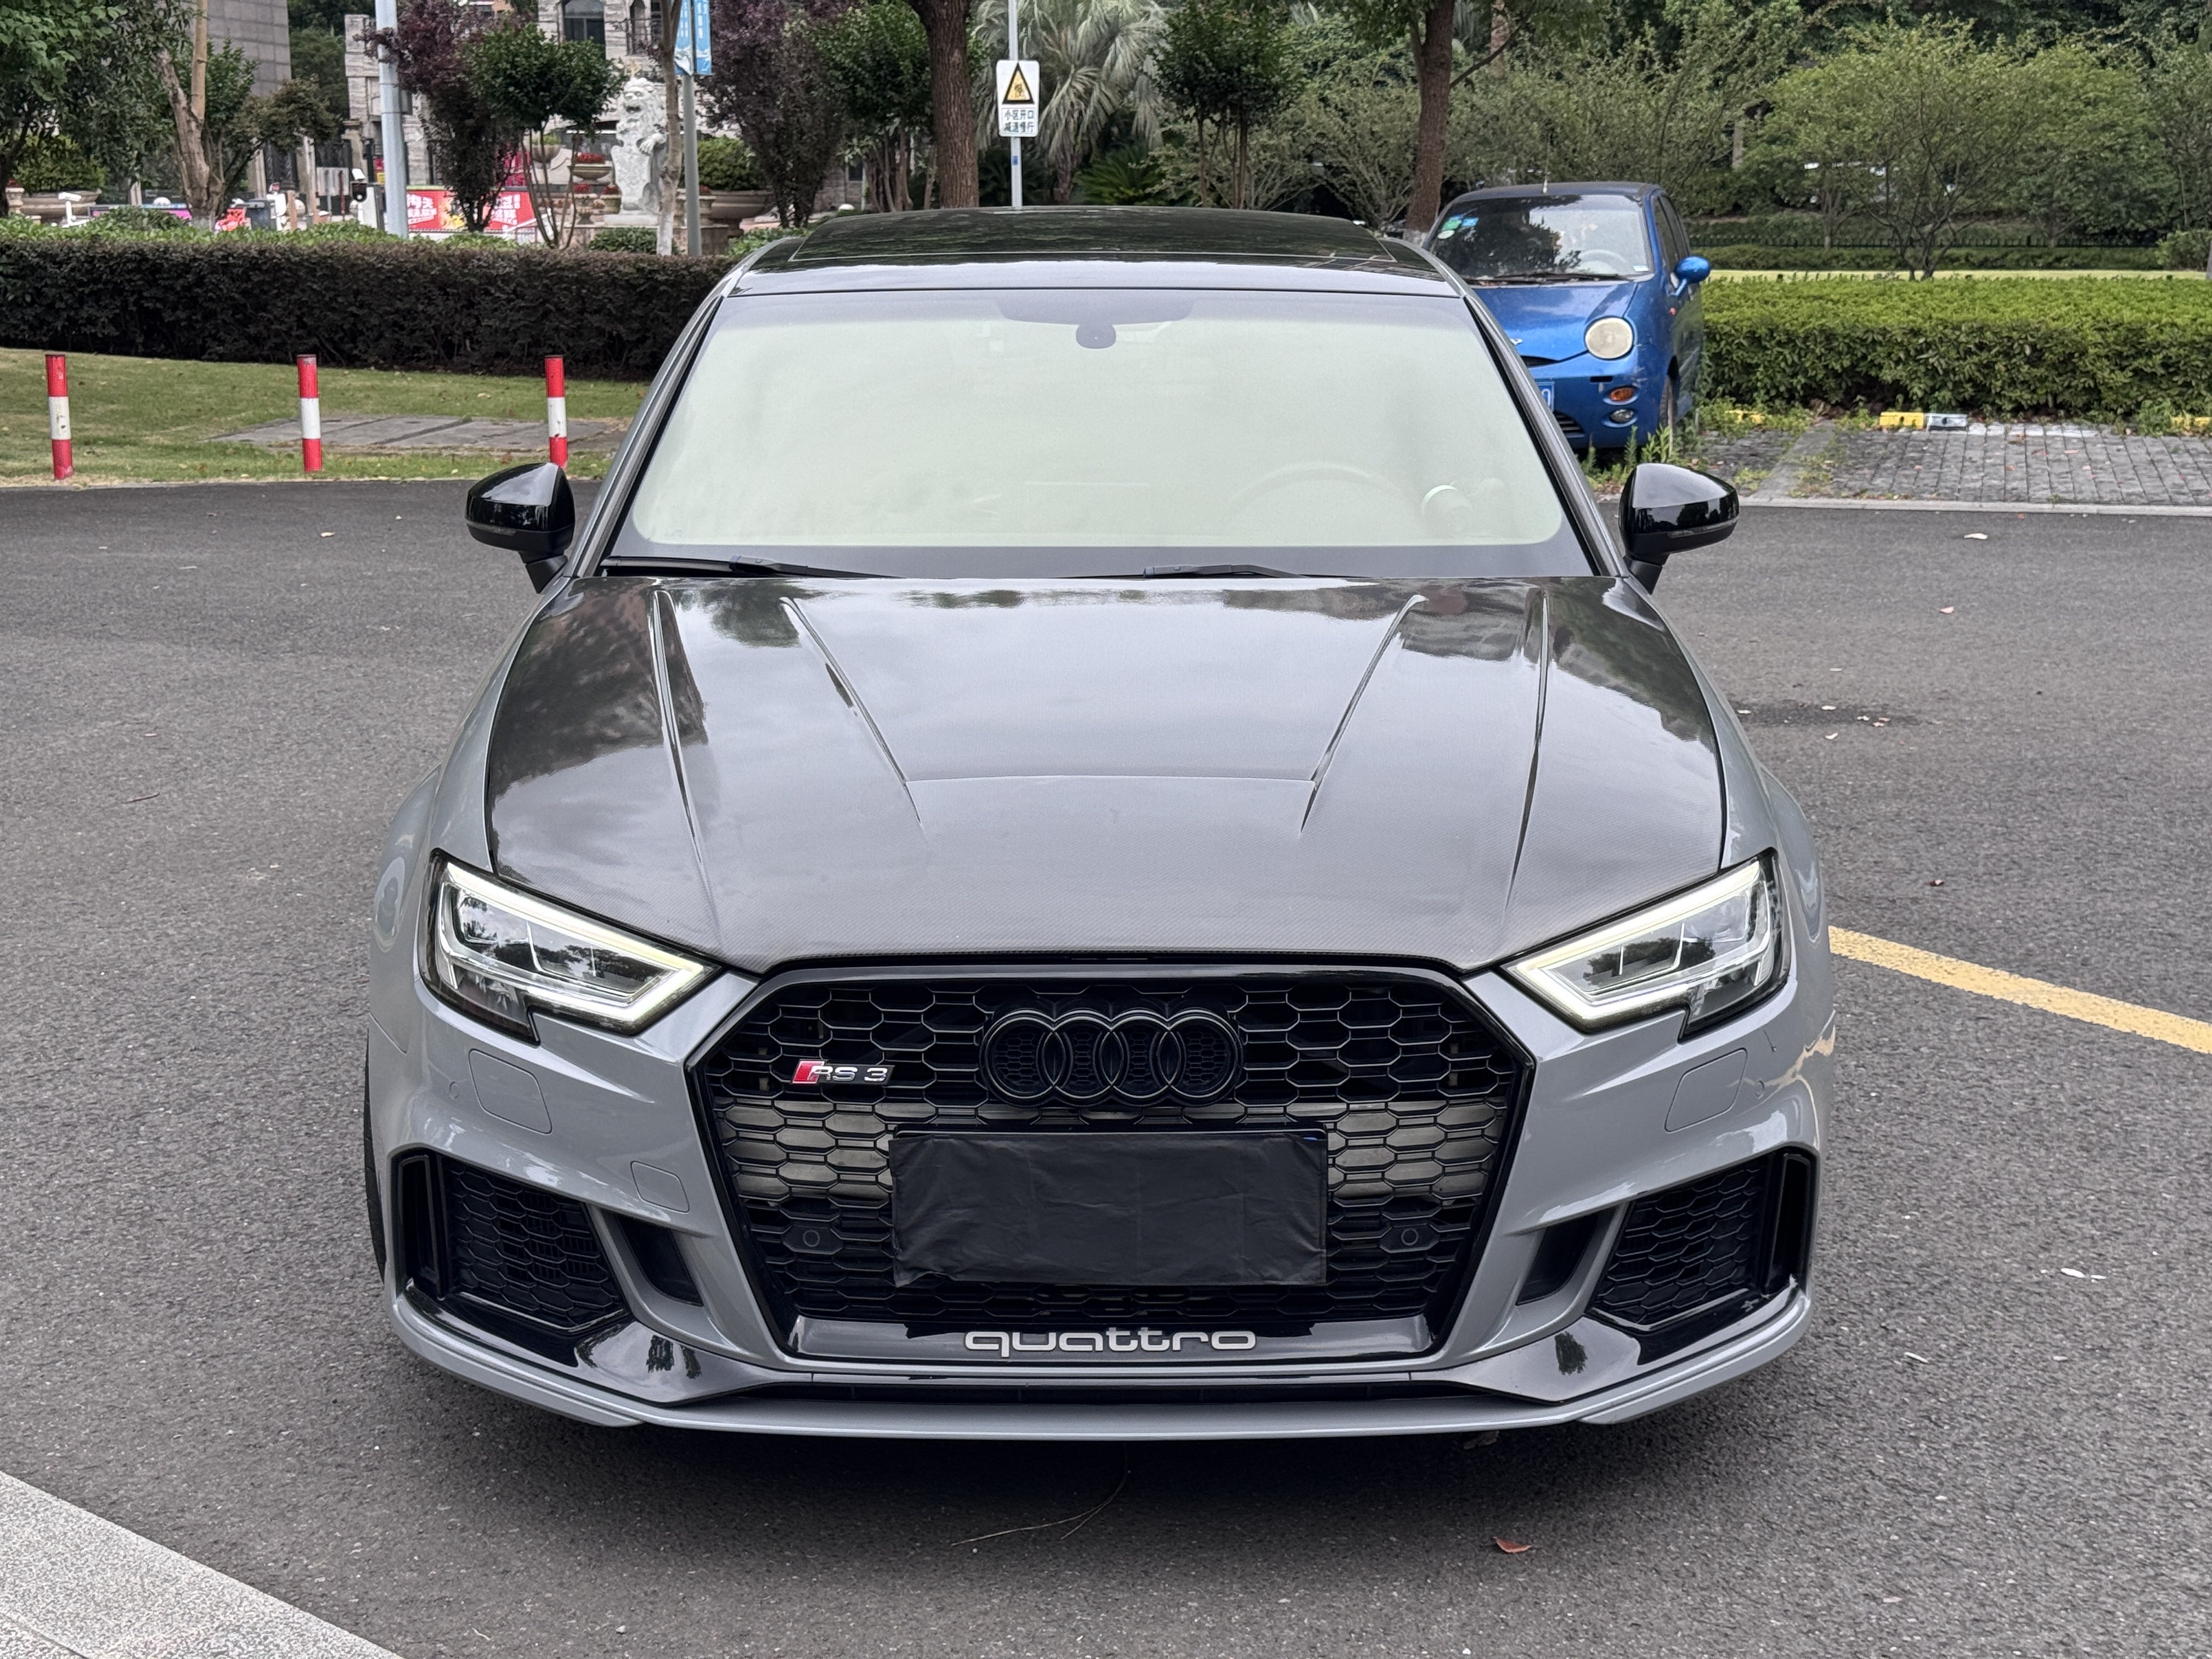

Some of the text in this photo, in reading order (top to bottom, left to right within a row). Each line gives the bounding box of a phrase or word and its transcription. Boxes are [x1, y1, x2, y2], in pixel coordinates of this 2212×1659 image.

[1004, 109, 1035, 121] 小区开口
[806, 1065, 888, 1082] RS 3
[964, 1327, 1256, 1358] quattro
